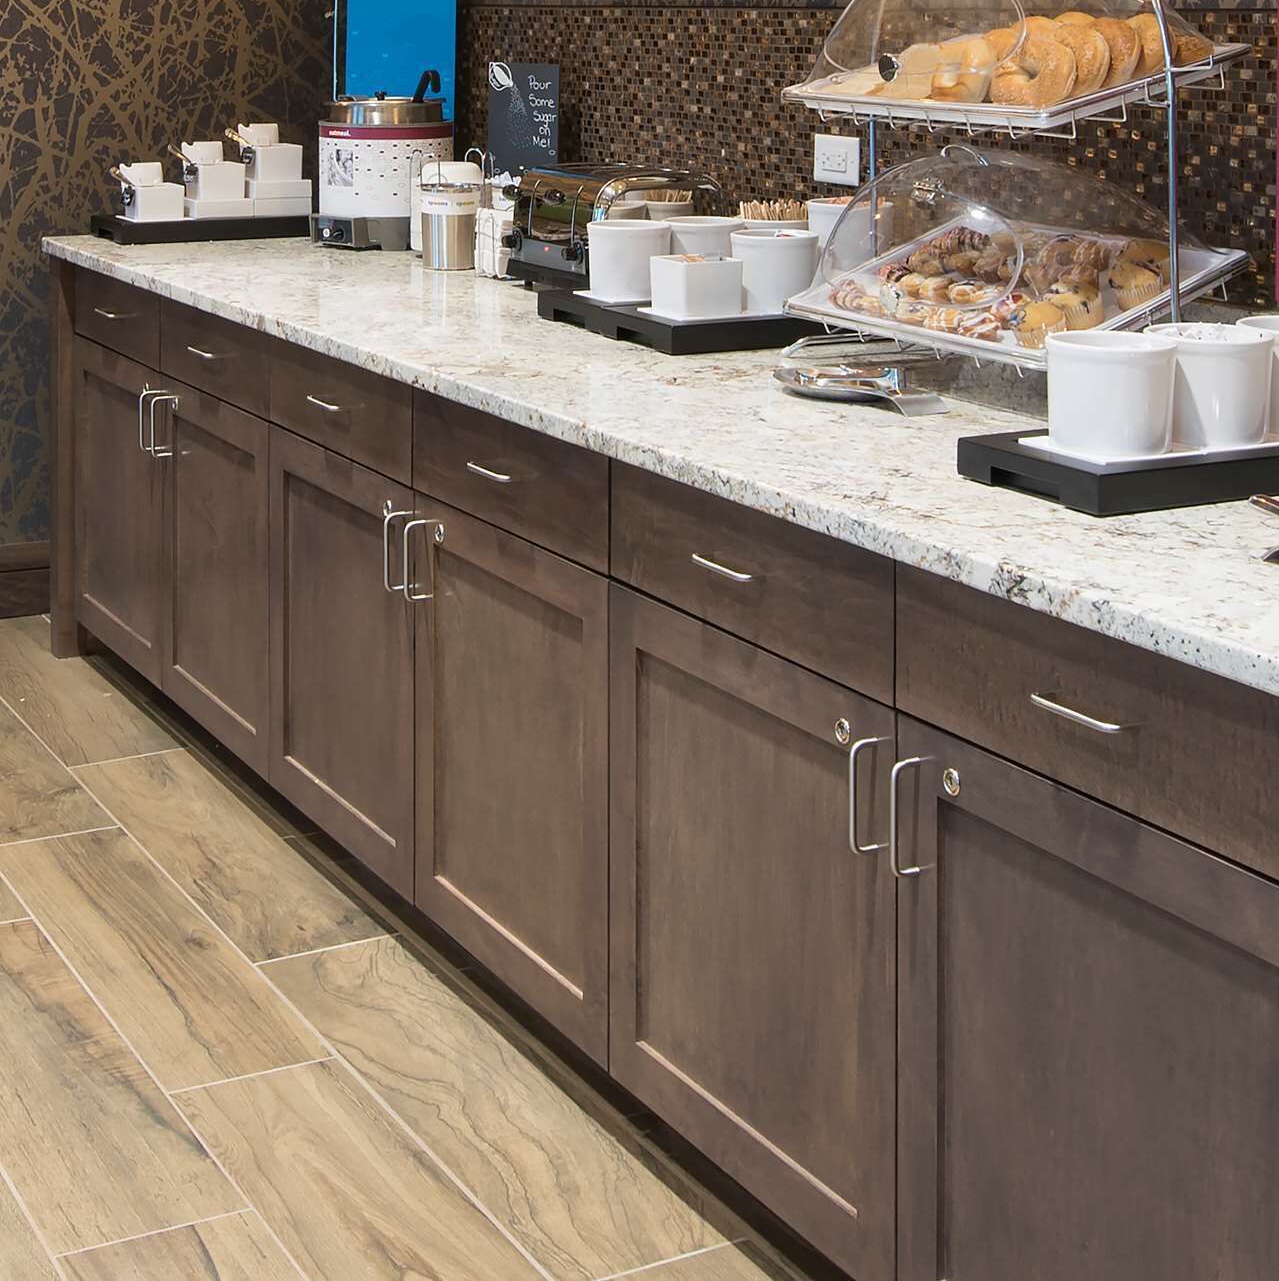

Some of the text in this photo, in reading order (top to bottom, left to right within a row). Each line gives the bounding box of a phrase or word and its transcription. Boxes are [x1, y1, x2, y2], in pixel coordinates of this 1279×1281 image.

[528, 74, 552, 90] Pour
[528, 93, 556, 109] Some
[532, 110, 557, 128] Sugar
[539, 126, 551, 136] on
